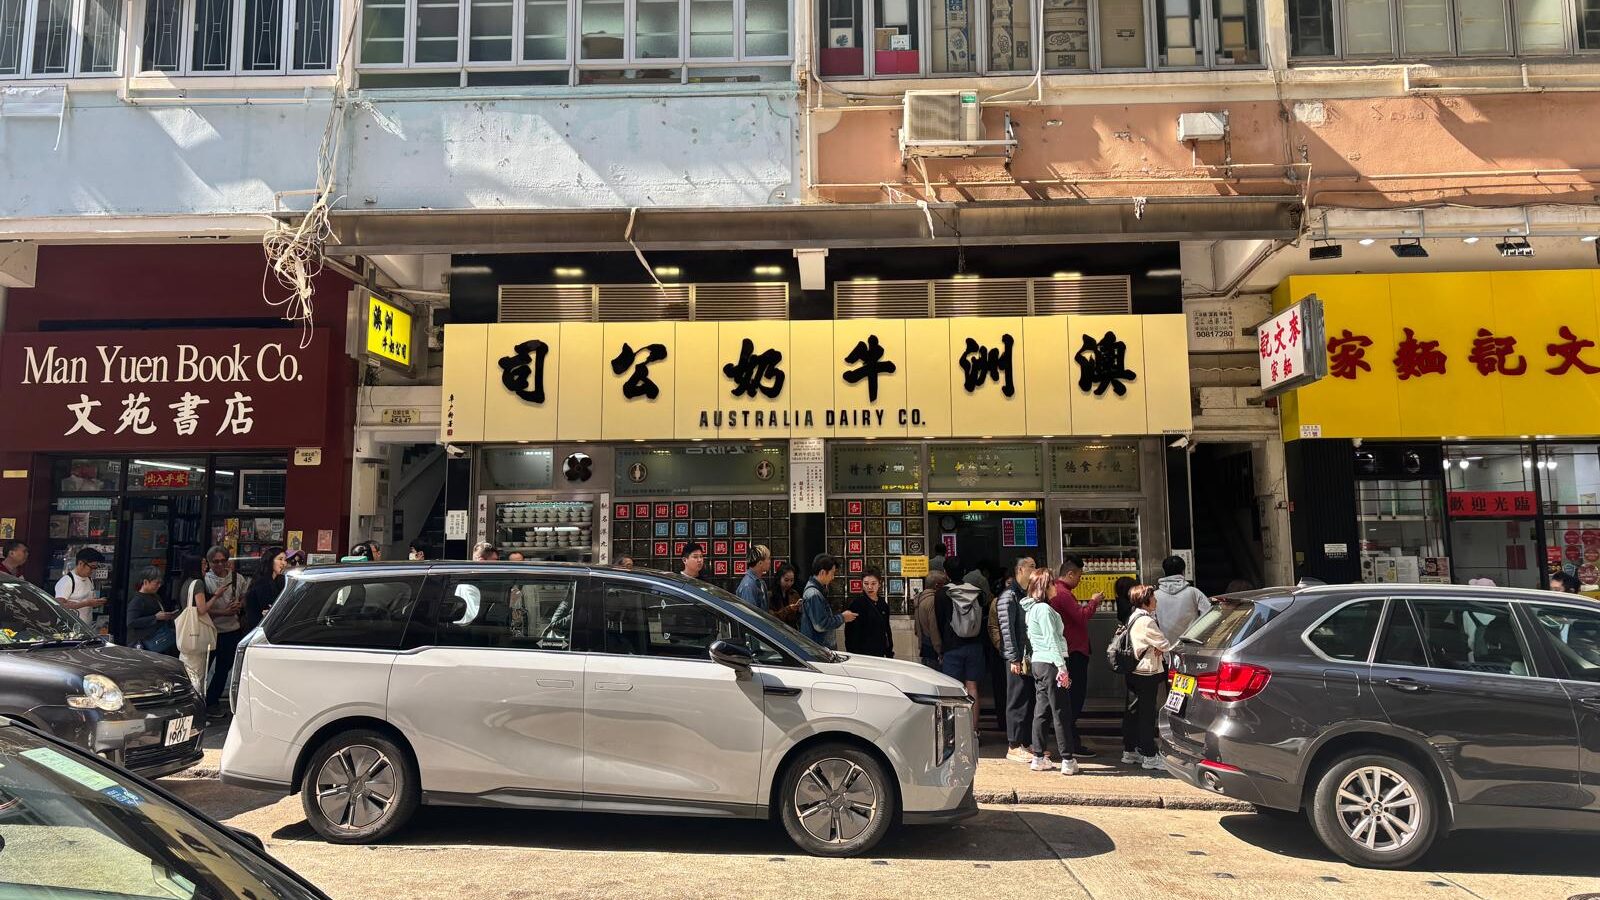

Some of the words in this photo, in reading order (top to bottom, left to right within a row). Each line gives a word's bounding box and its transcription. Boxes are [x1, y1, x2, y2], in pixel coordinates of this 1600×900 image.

[373, 304, 394, 337] 澳洲
[1196, 330, 1233, 338] 90817280
[1259, 310, 1301, 360] 麥文記
[382, 336, 407, 360] 牛奶公司
[22, 347, 88, 384] Man
[96, 346, 168, 384] Yuen
[175, 344, 251, 383] Book
[257, 343, 304, 382] Co.
[498, 332, 1136, 403] 澳洲牛奶公司
[64, 391, 253, 437] 文苑書店
[699, 411, 814, 428] AUSTRALIA
[826, 410, 884, 426] DAIRY
[898, 409, 926, 426] CO.
[1449, 496, 1531, 512] 歡迎光臨
[175, 717, 187, 731] UX
[168, 728, 188, 745] 1907
